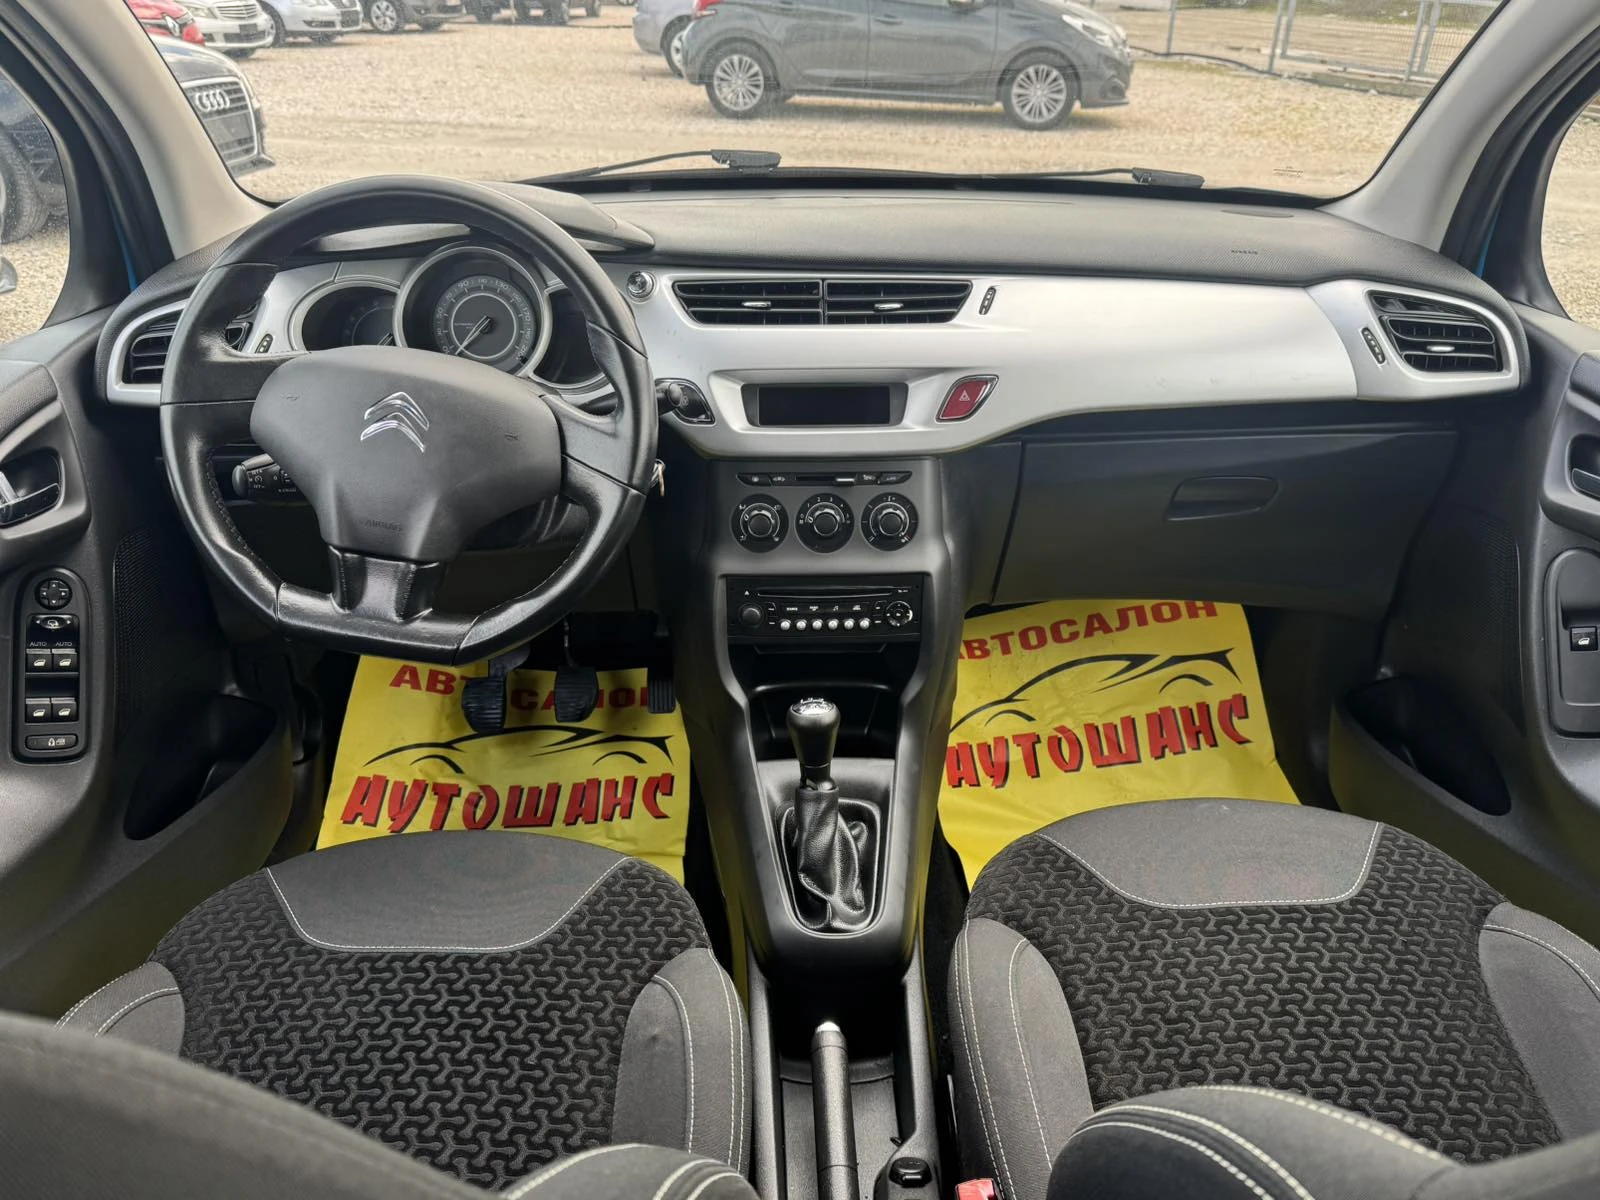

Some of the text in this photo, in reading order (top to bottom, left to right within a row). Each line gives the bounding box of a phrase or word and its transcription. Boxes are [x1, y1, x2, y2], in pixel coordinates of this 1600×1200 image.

[959, 600, 1218, 660] ВТОСАЛОН
[945, 693, 1254, 788] АУТОШАНС
[340, 773, 674, 833] АУТОШАНС
